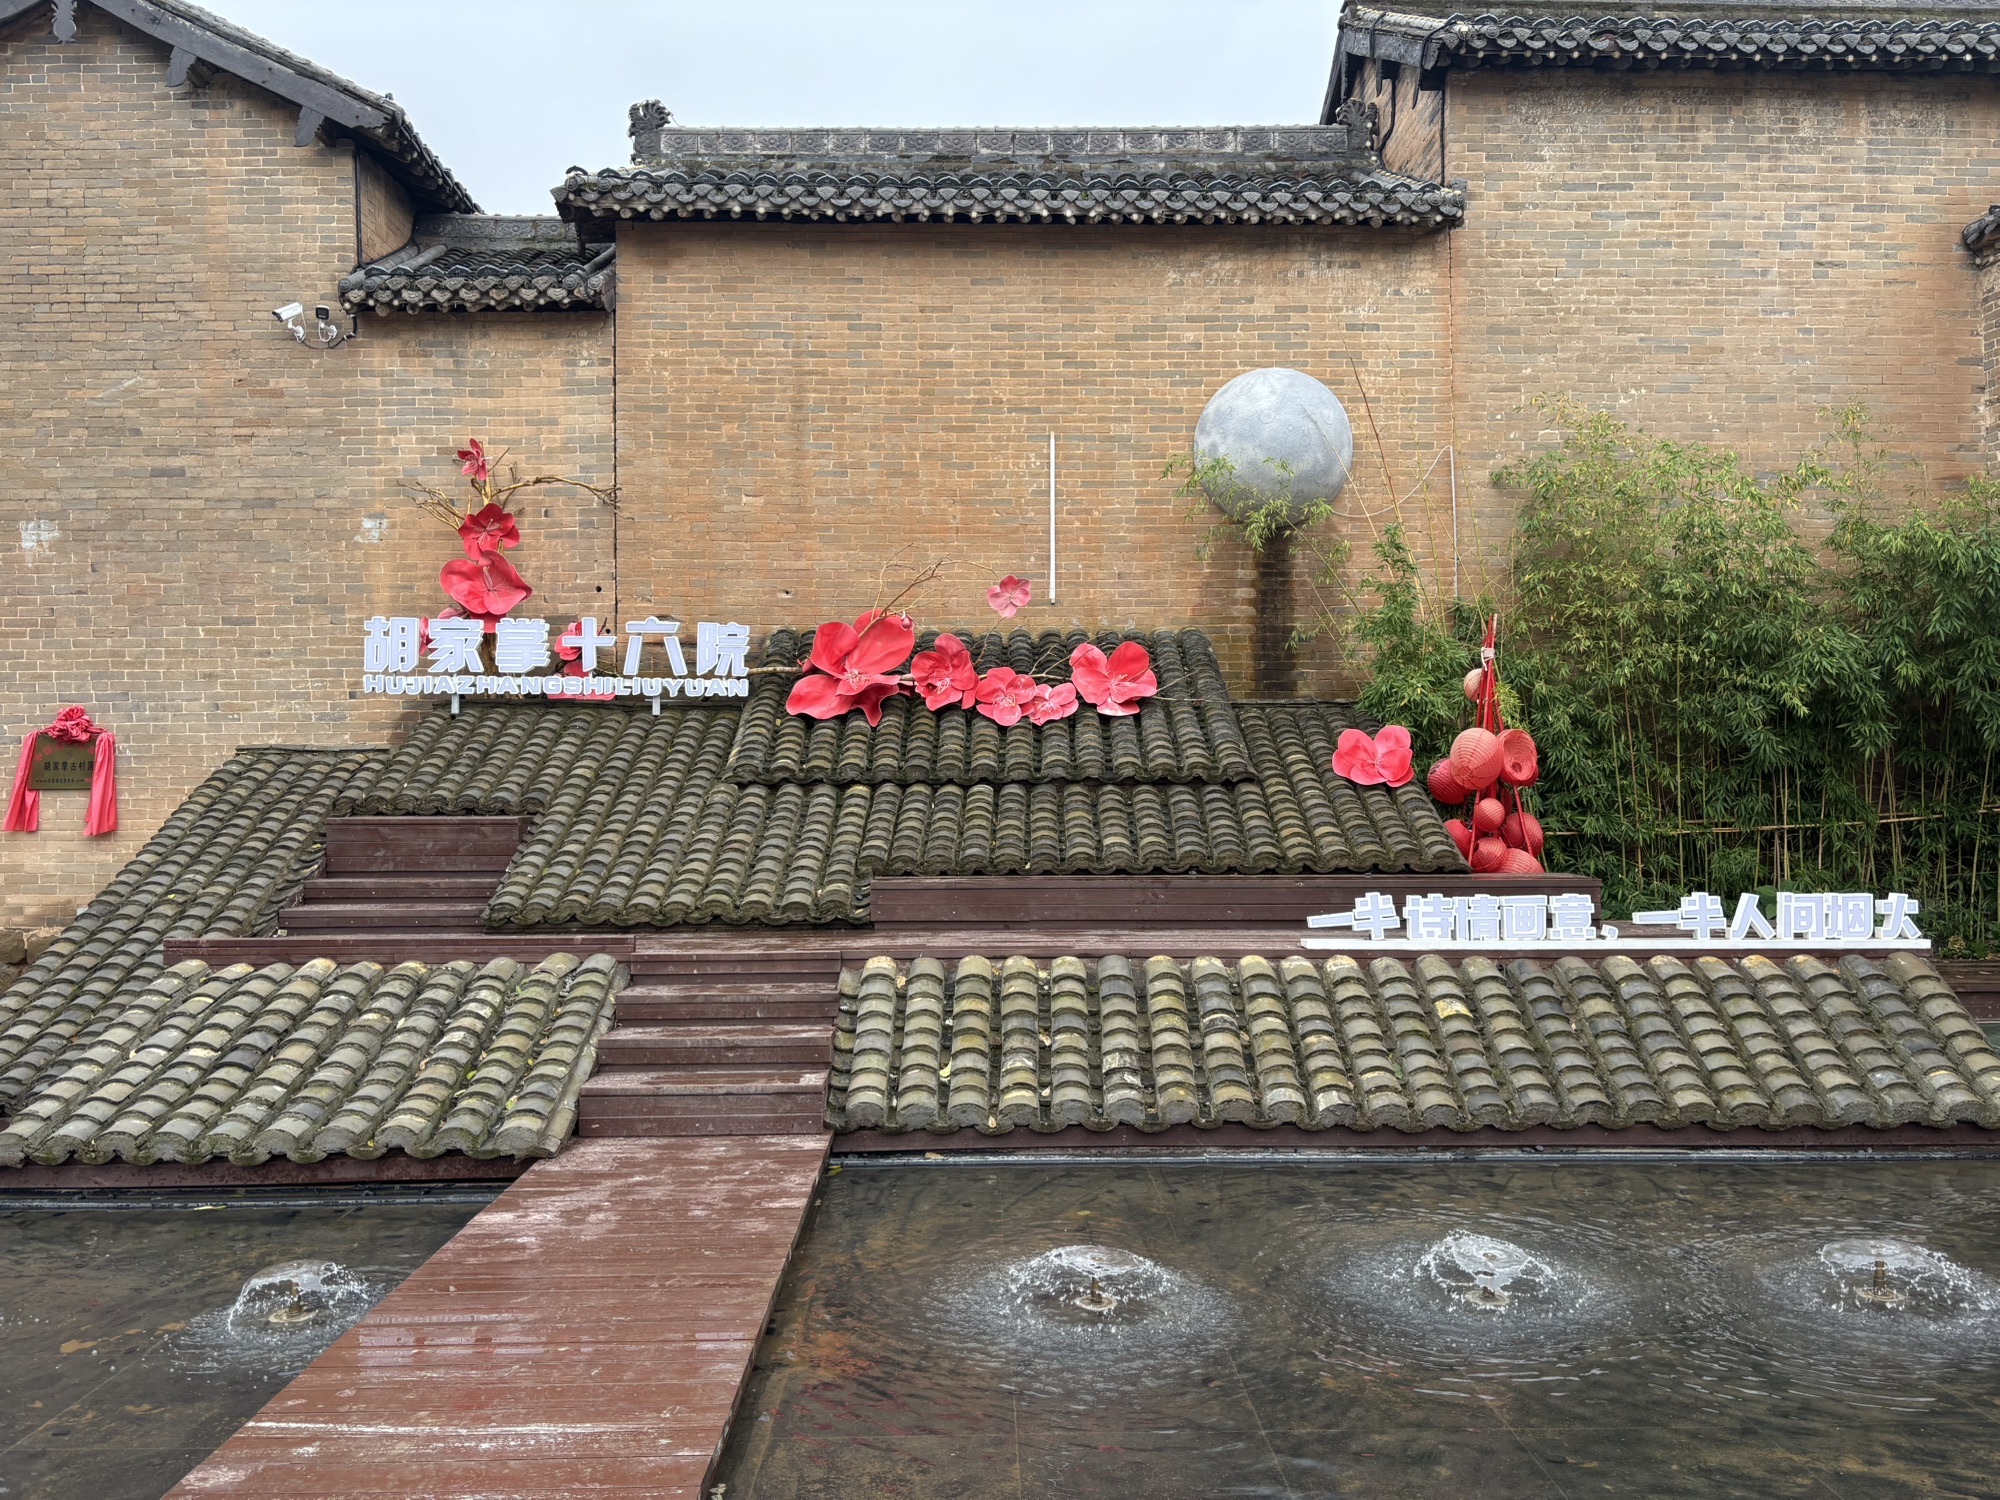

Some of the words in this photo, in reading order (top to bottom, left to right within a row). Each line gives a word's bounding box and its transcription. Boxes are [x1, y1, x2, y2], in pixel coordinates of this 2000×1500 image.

[364, 616, 751, 677] 胡家掌十六院
[363, 674, 750, 696] HUJIAZHANGSHILIUYUAN
